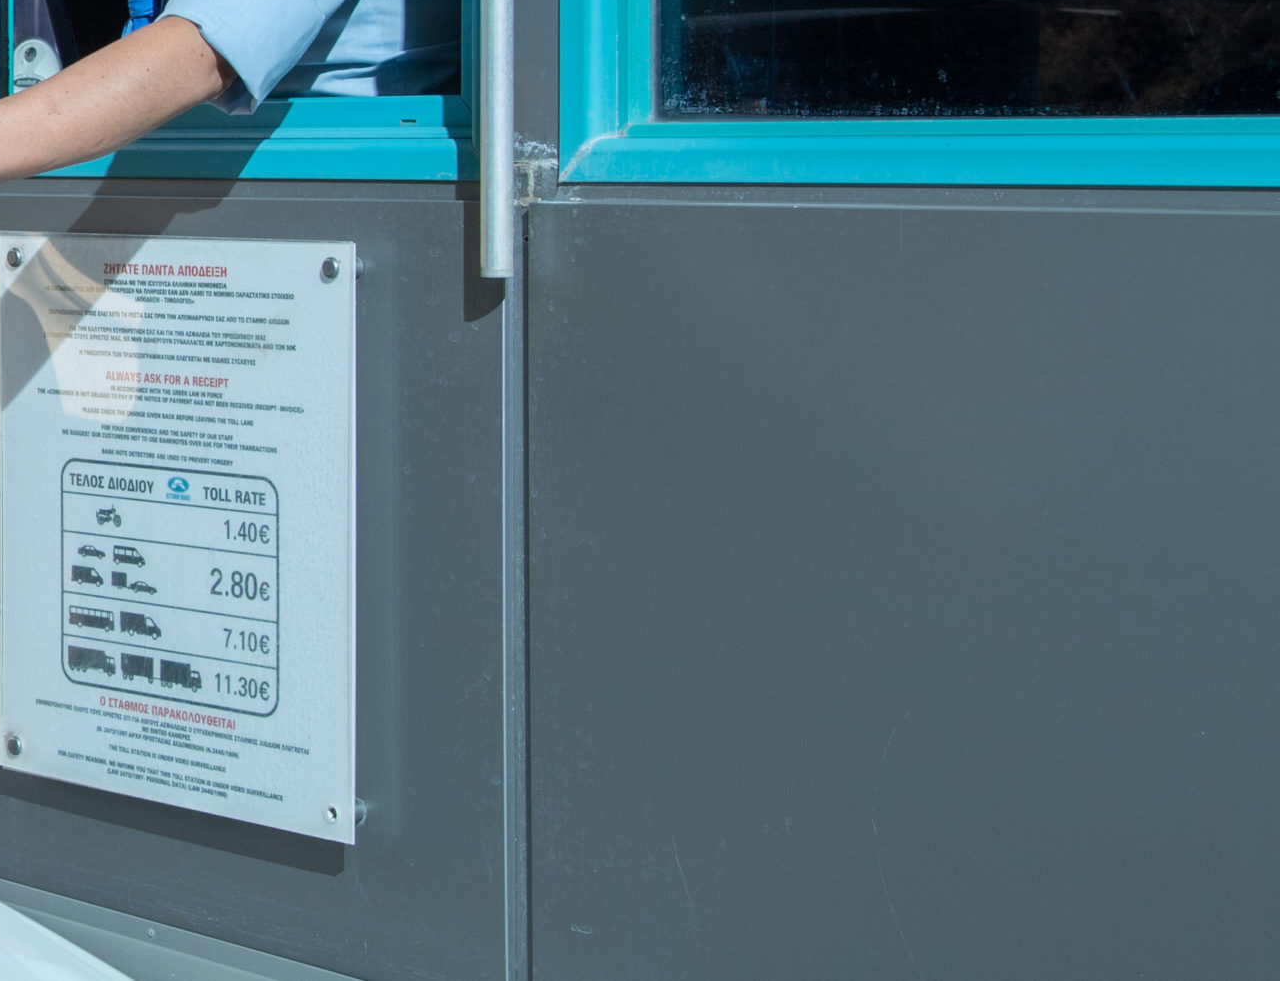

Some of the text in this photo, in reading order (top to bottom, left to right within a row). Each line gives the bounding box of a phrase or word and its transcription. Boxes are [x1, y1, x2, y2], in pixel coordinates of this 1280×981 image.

[103, 263, 227, 277] ΖΗΤΑΤΕ ΠΑΝΤΑ ΑΠΟΔΕΙΞΗ
[105, 370, 229, 388] ALWAYS ASK FOR A RECEIPT
[69, 472, 154, 494] ΤΕΛΟΣ ΔΙΟΔΙΟΥ
[202, 486, 266, 506] TOLL RATE
[223, 518, 270, 545] 1.40€
[210, 566, 270, 603] 2.80€
[222, 626, 270, 655] 7.10€
[214, 671, 270, 702] 11.30€
[99, 695, 105, 706] Ο
[107, 696, 149, 714] ΣΤΑΘΜΟΣ
[151, 704, 235, 730] ΠΑΡΑΚΟΛΟΥΘΕΙΤΑΙ
